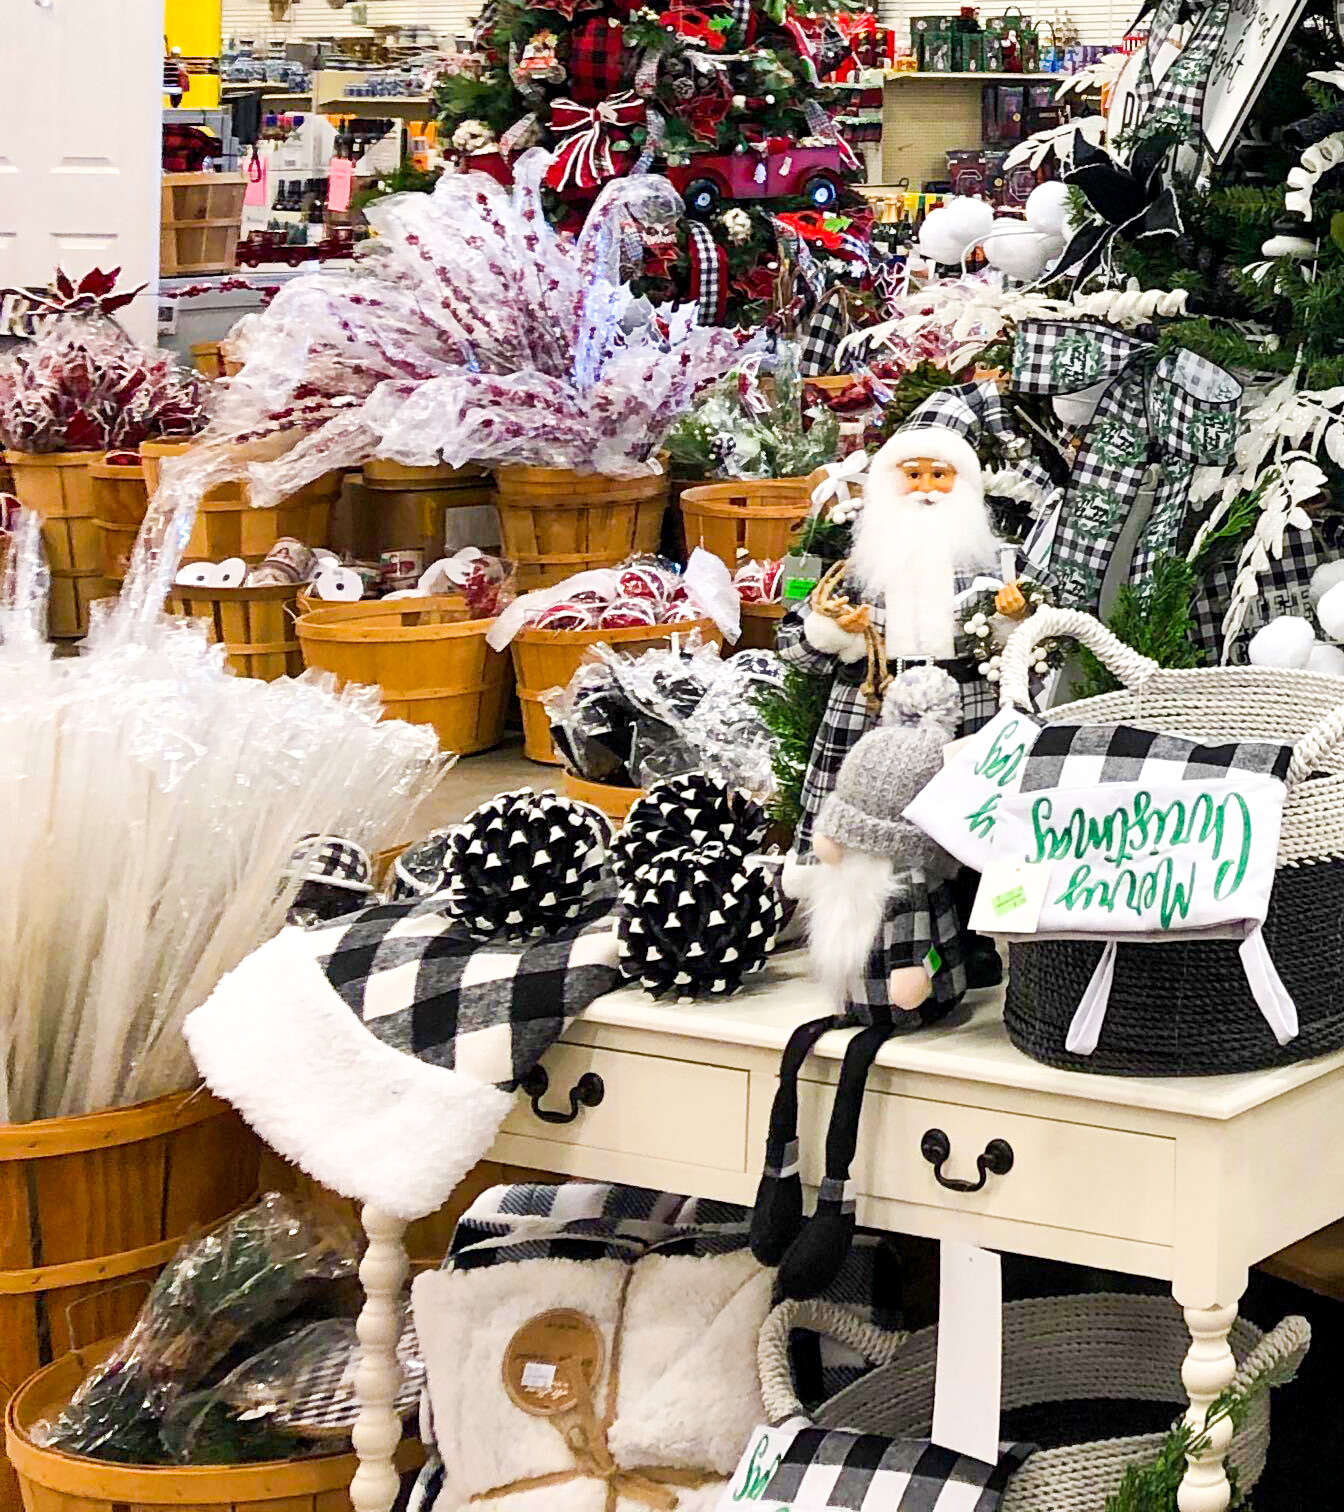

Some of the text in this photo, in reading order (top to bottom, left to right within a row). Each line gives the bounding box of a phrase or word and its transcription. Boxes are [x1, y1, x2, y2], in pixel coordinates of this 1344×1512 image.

[1212, 38, 1247, 95] ight
[1025, 790, 1252, 901] Christmas
[1054, 855, 1196, 930] Merry
